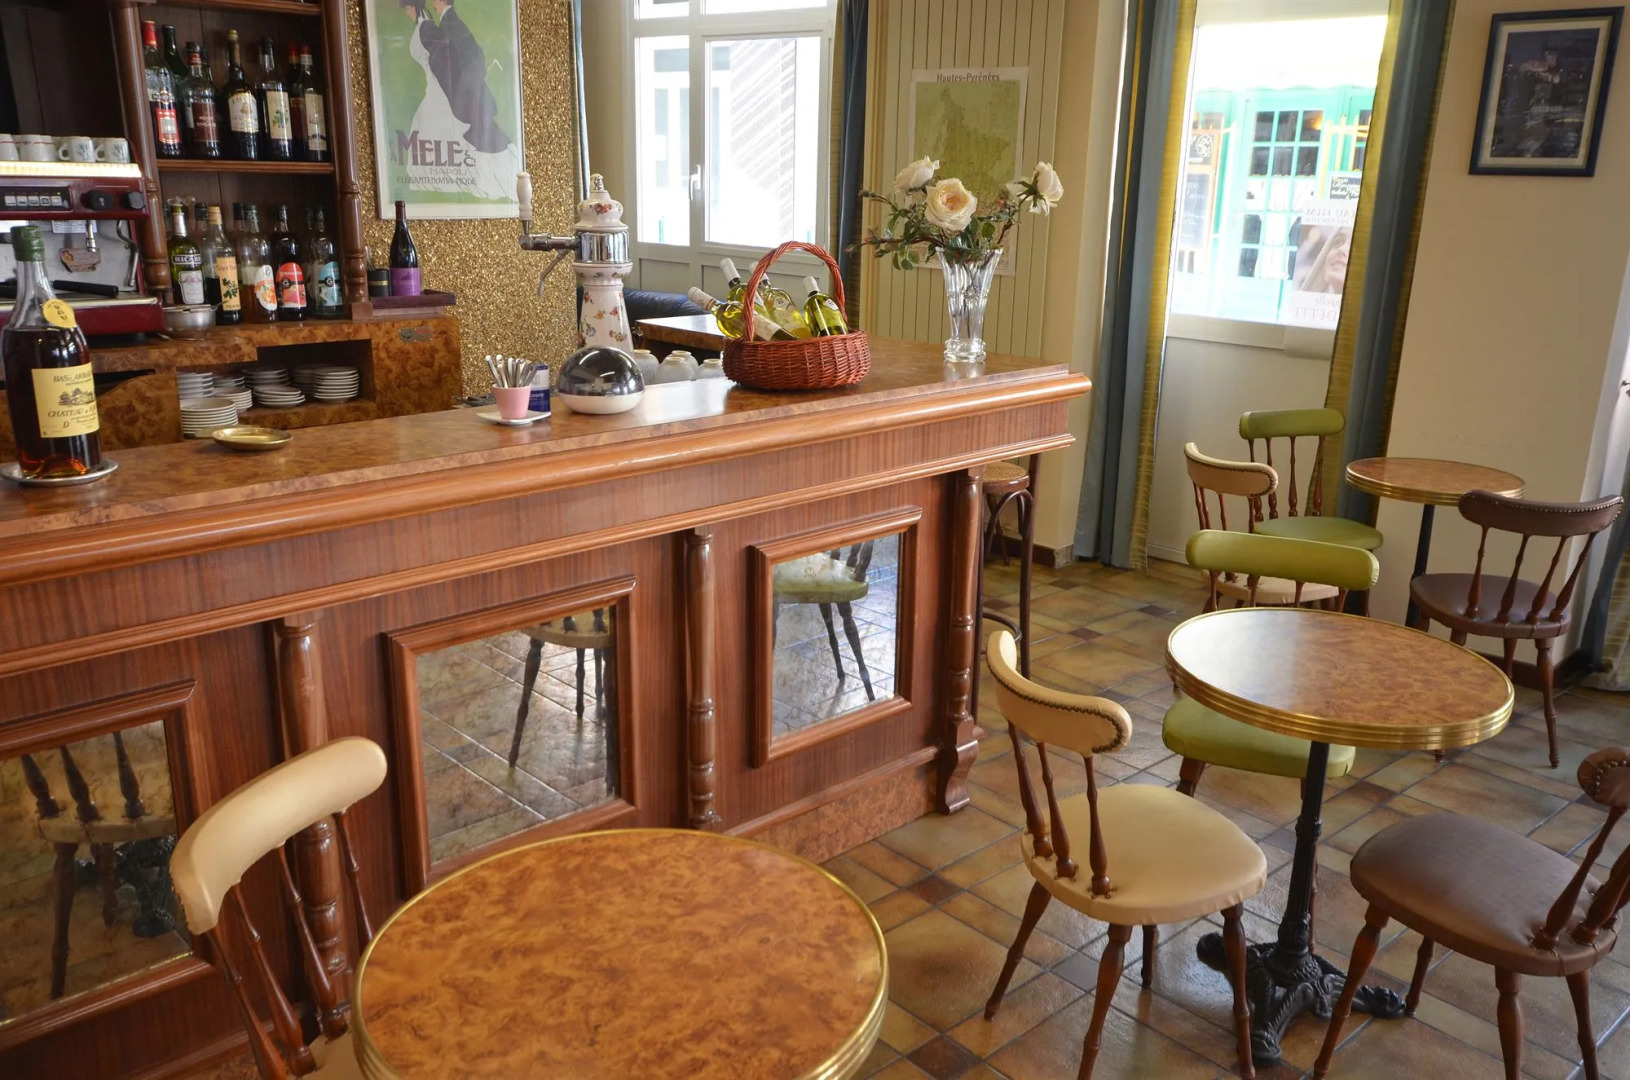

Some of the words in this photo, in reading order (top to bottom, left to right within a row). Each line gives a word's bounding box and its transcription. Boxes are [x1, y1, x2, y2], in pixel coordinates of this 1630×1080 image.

[936, 72, 1000, 83] Hautes-Pyrénées
[396, 131, 463, 166] MELE
[430, 168, 468, 176] NAPOLI
